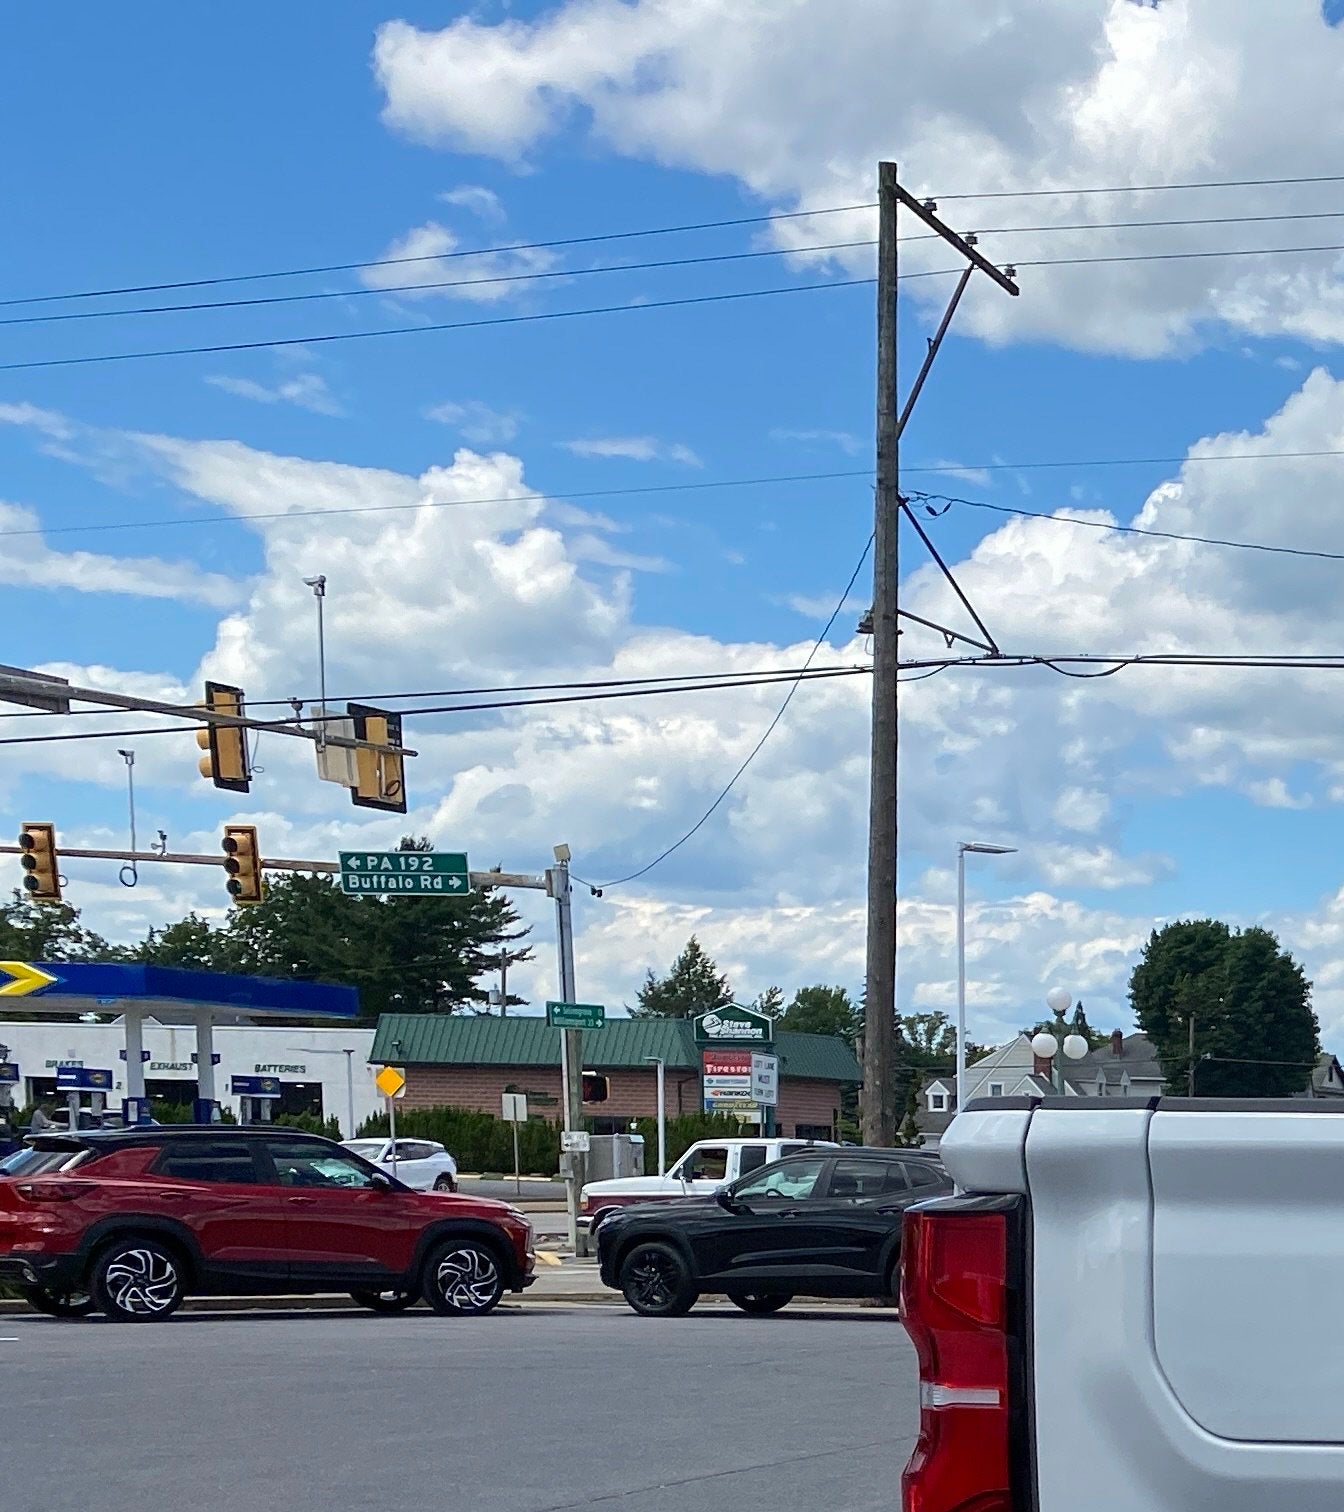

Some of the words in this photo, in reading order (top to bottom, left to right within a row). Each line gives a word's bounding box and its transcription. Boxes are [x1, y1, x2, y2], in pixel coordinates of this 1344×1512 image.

[366, 856, 393, 871] PA
[399, 856, 434, 871] 192
[349, 875, 414, 889] Buffalo
[420, 875, 443, 890] Rd
[722, 1020, 752, 1029] Steve
[720, 1026, 763, 1035] Shannon
[150, 1062, 194, 1071] EXHAUST
[254, 1064, 306, 1074] BATTERIES
[705, 1064, 752, 1074] Firesto
